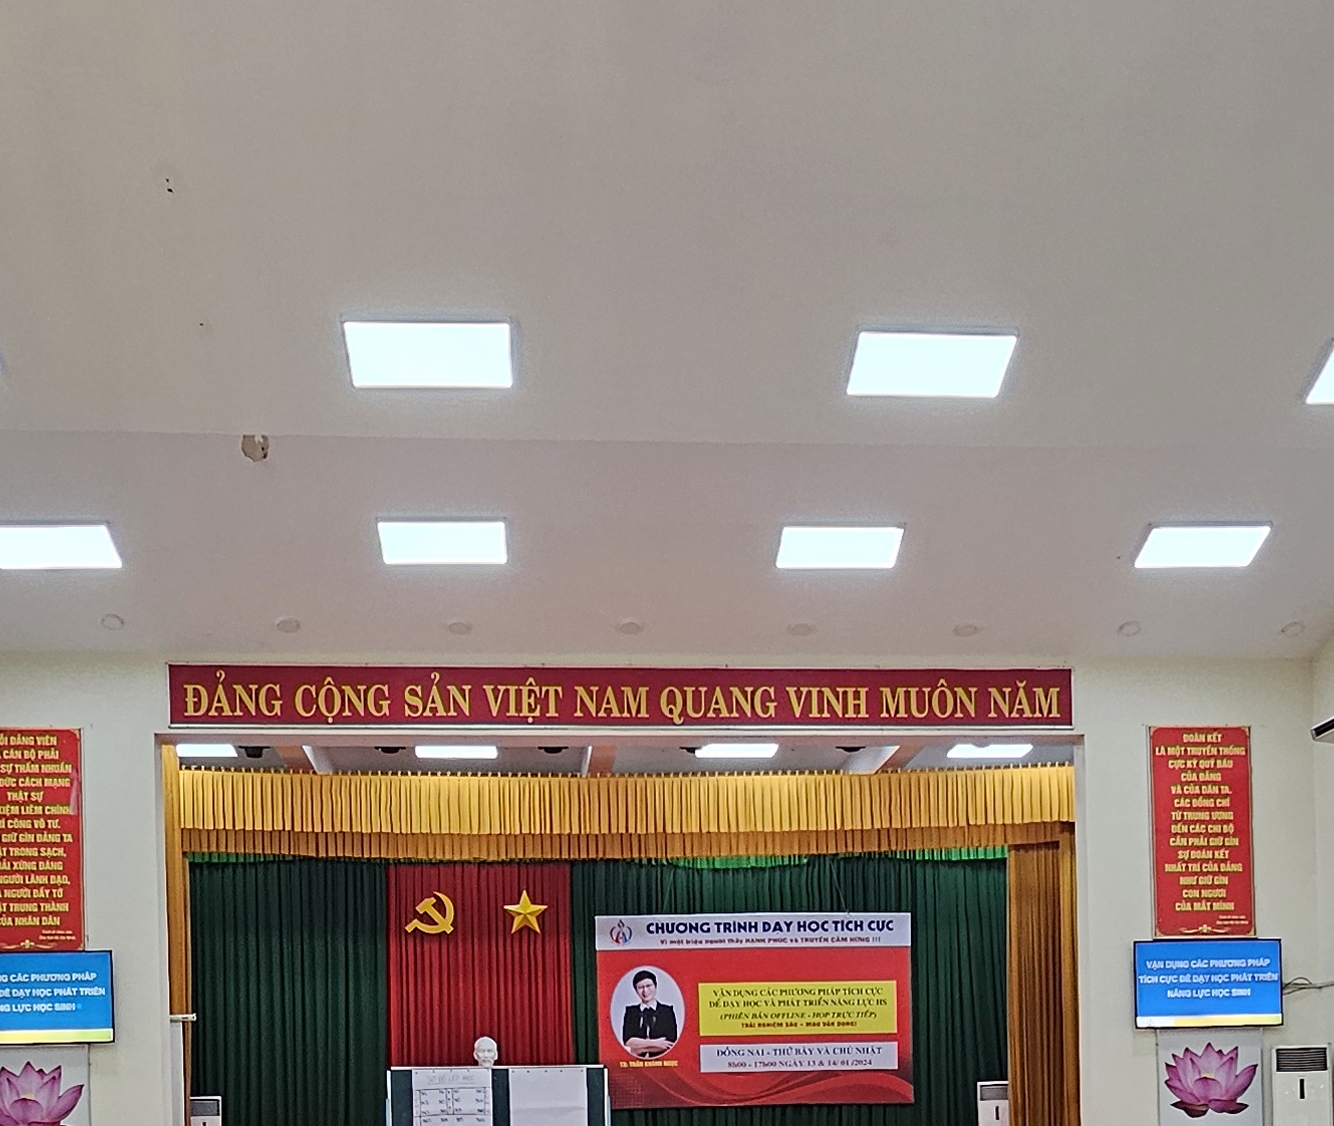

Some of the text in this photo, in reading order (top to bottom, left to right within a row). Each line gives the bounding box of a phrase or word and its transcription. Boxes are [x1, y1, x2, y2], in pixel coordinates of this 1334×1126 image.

[184, 670, 1060, 725] ĐẢNG CỘNG SẢN VIỆT NAM QUANG VINH MUÔN NĂM
[62, 834, 73, 842] TA
[646, 919, 893, 934] CHƯƠNG TRÌNH DẠY HỌC TÍCH CỰC
[760, 987, 778, 996] CÁC
[817, 1046, 830, 1055] VÀ
